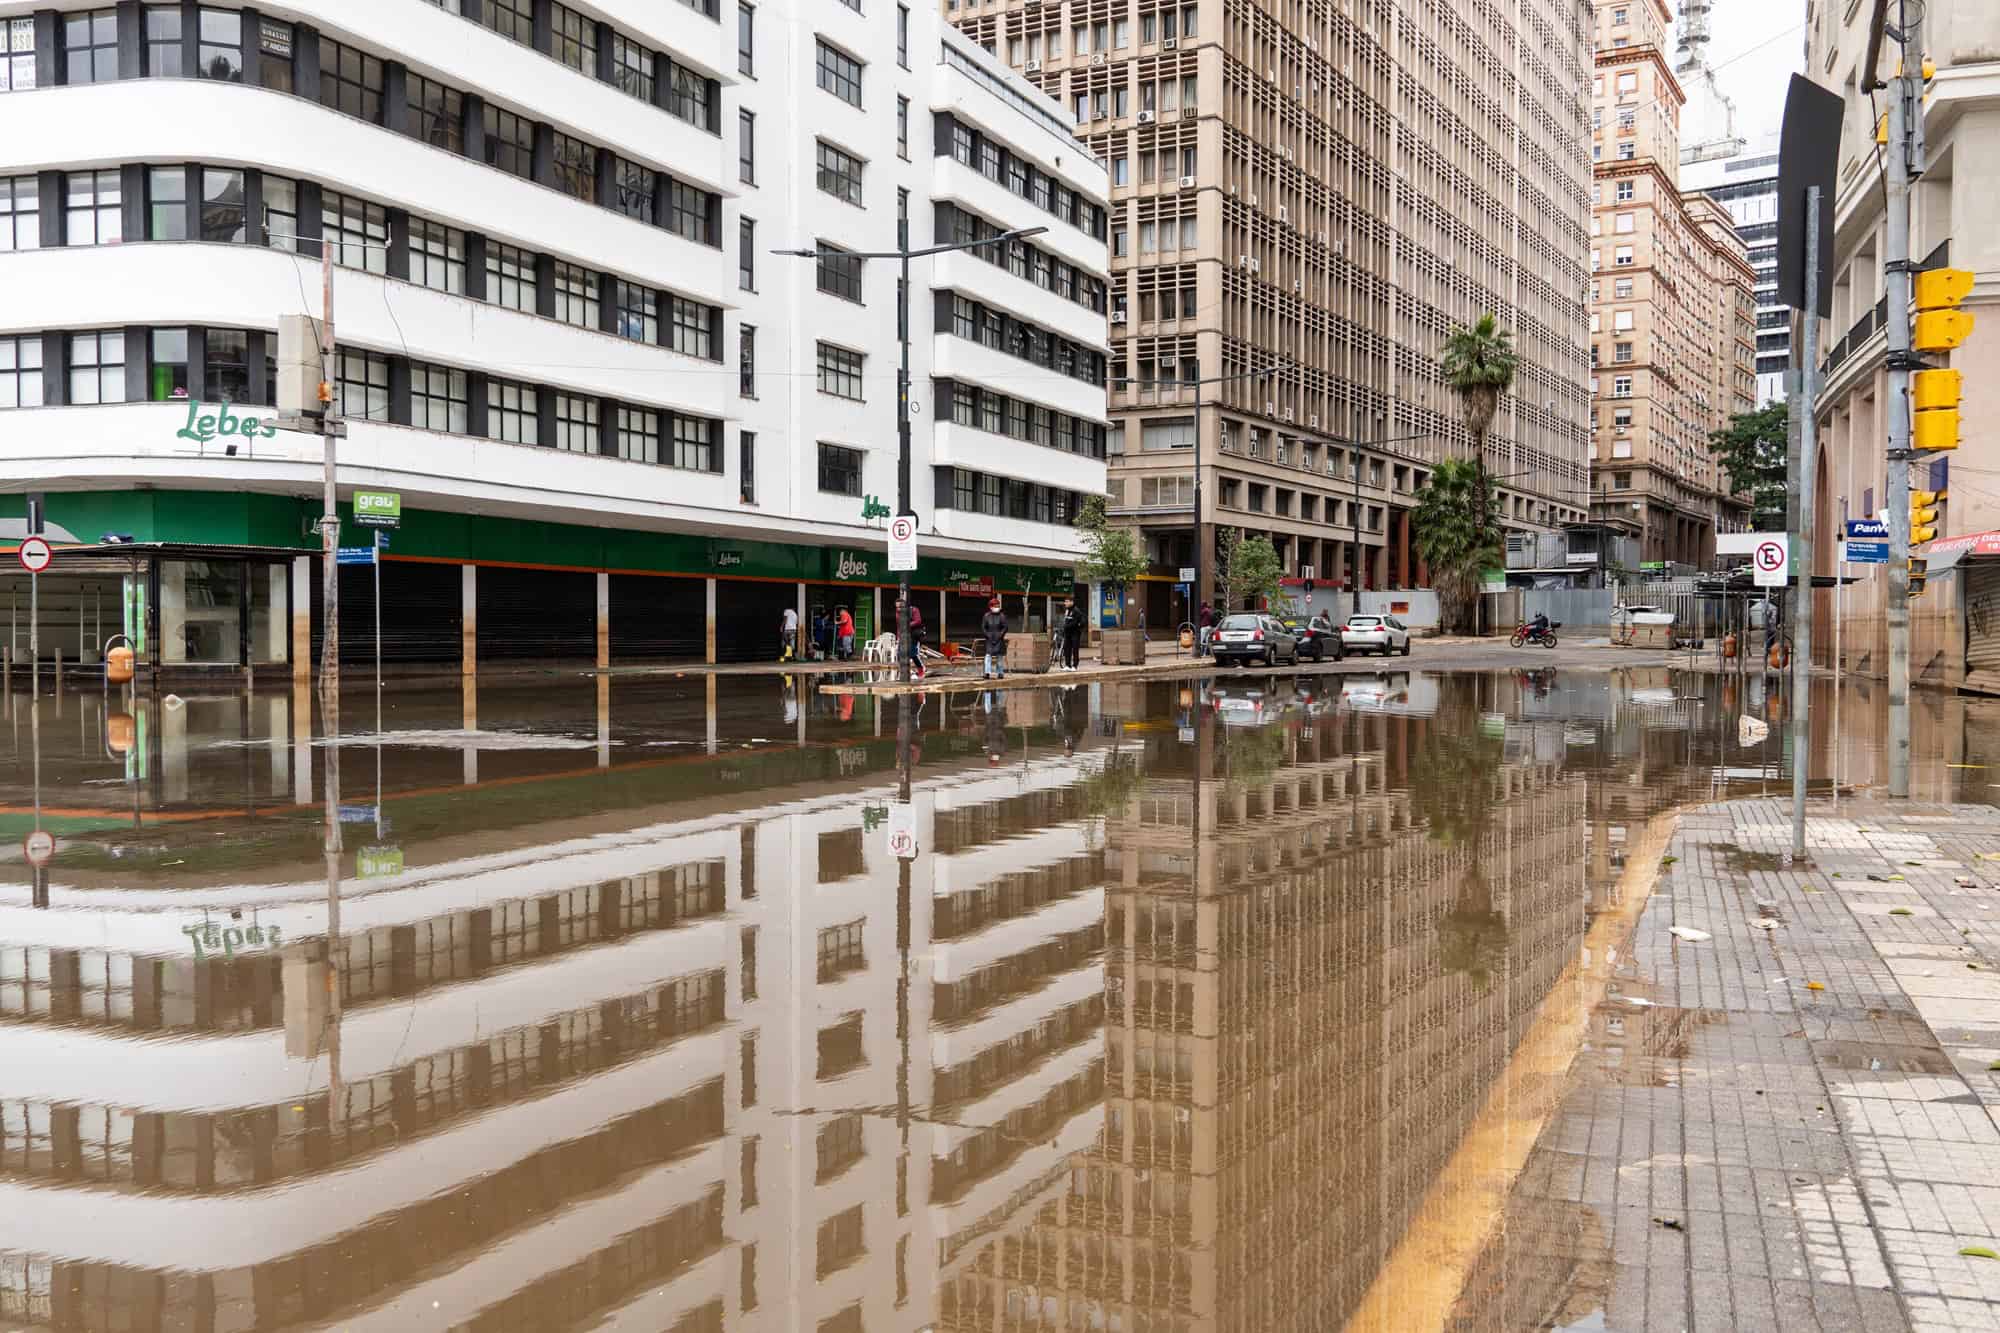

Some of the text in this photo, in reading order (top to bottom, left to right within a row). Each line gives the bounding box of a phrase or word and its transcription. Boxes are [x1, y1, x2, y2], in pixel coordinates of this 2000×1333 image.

[176, 399, 276, 442] Lebes
[718, 552, 740, 565] Lebes
[835, 551, 868, 580] Lebes
